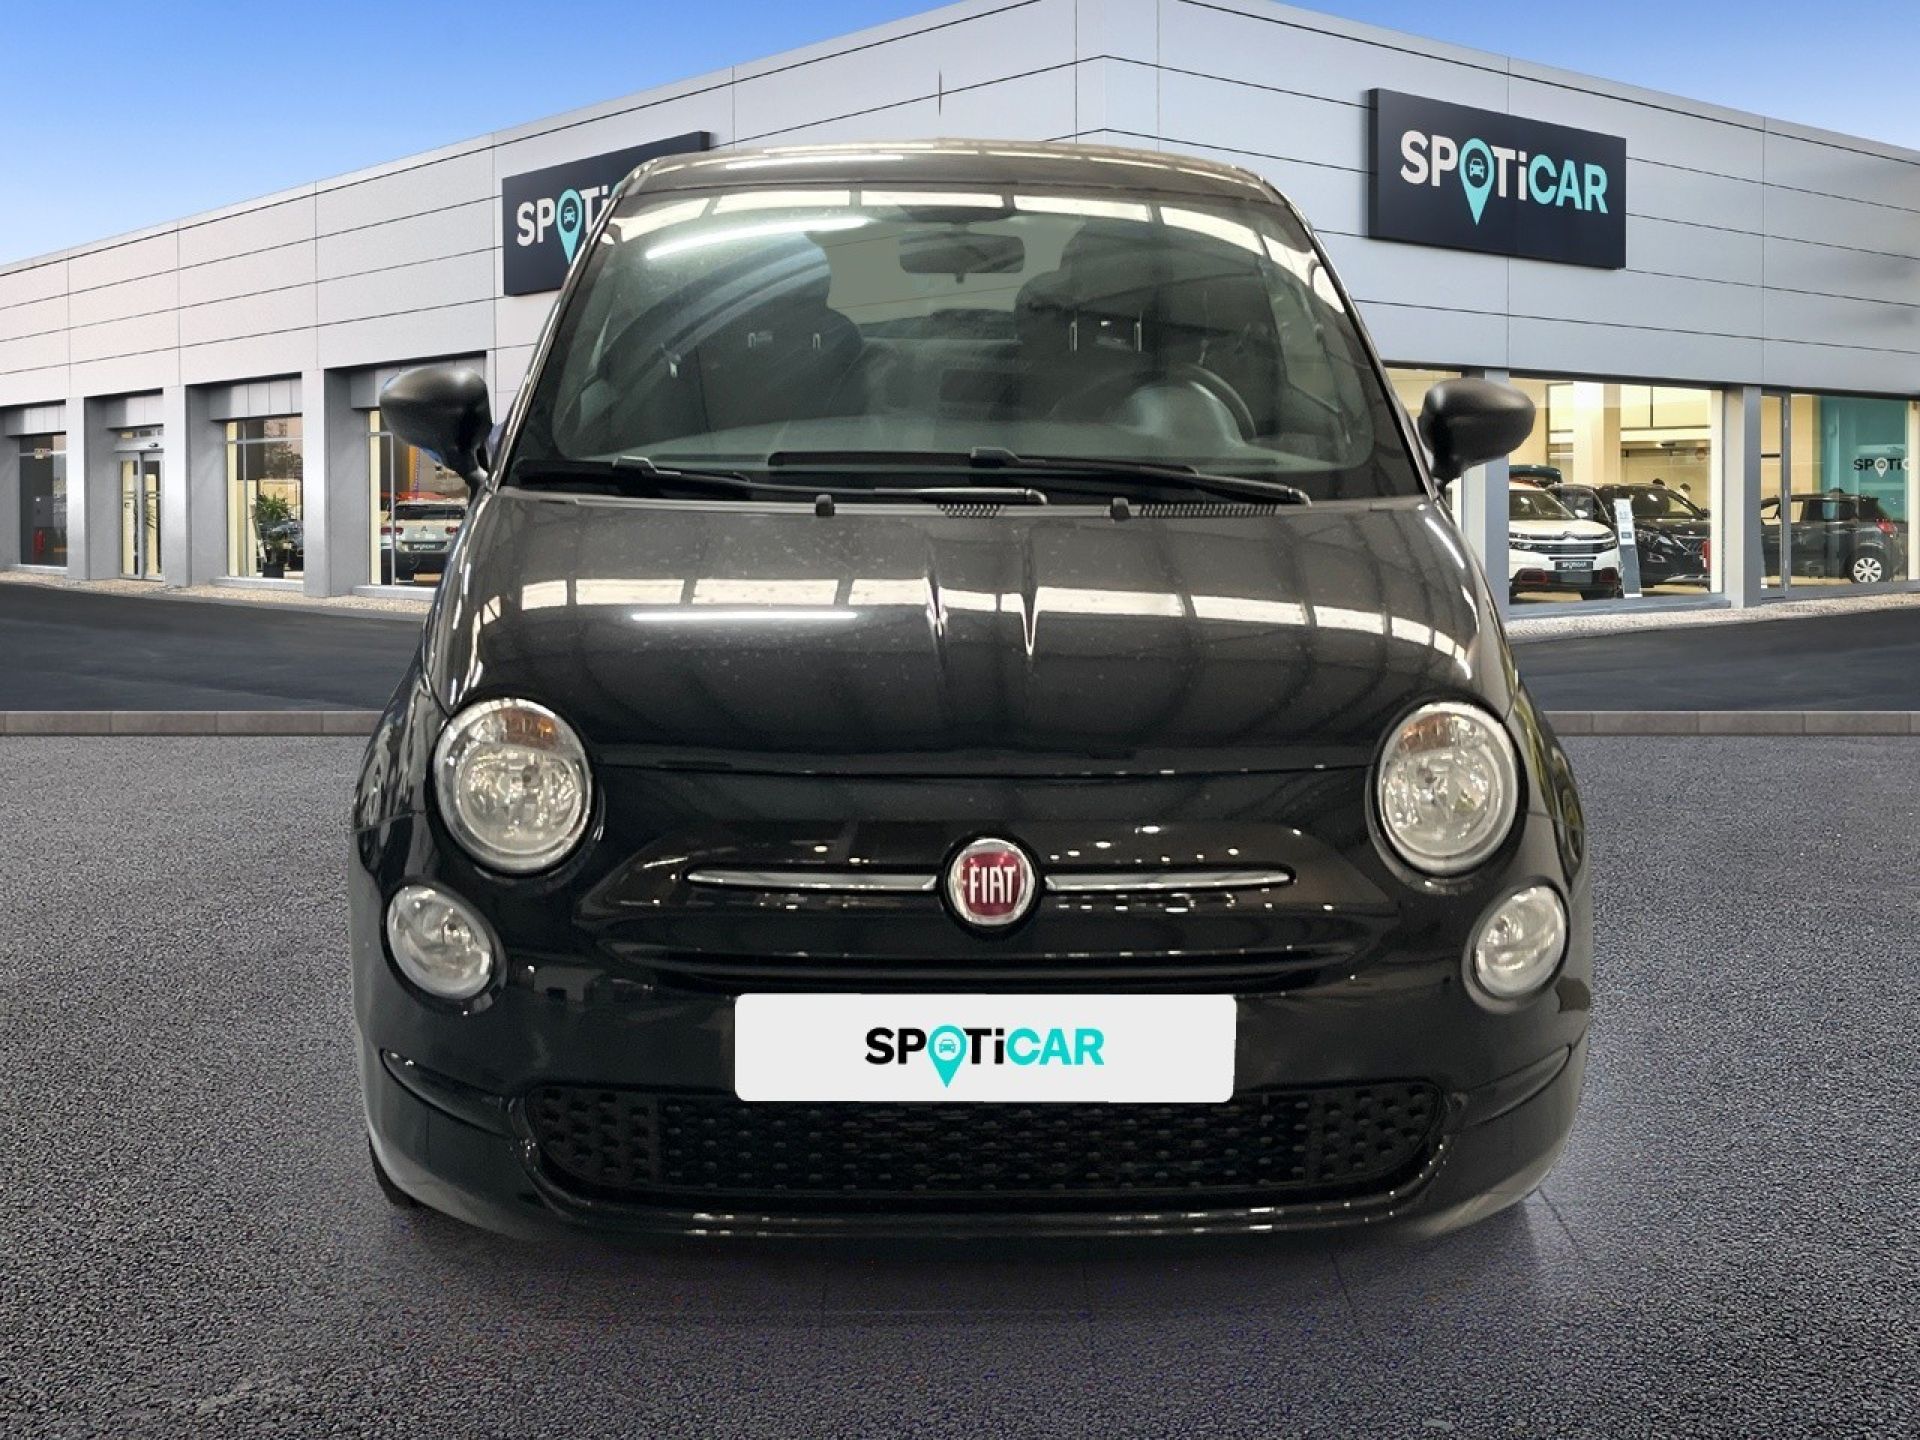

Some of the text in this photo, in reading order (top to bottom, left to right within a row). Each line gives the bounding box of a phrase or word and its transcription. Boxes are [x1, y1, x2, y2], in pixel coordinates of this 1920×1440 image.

[1400, 130, 1609, 226] SPOTiCAR
[516, 182, 620, 264] SPOTi
[969, 865, 1017, 904] FIAT
[865, 1025, 1105, 1089] SPOTiCAR
